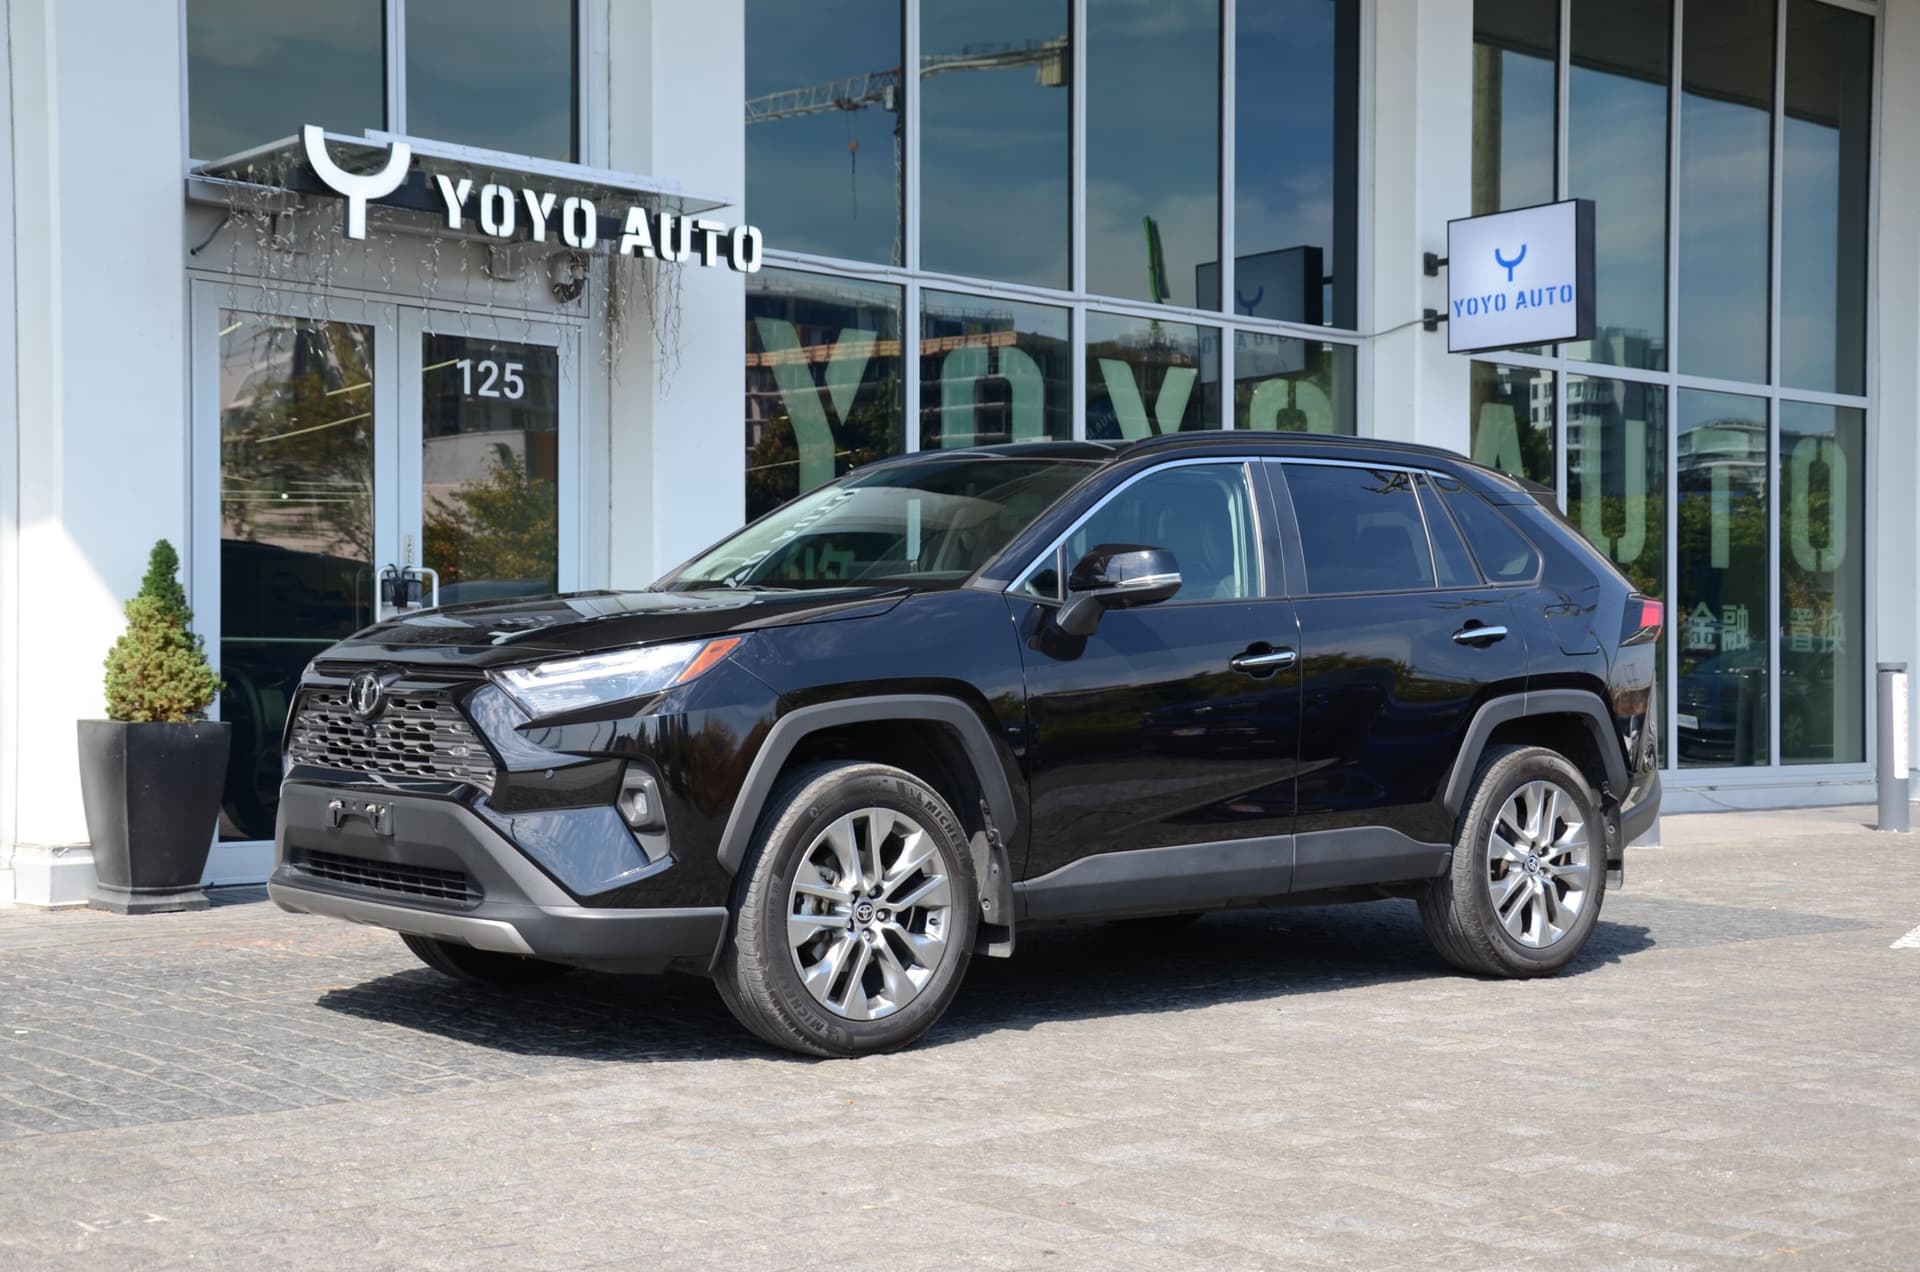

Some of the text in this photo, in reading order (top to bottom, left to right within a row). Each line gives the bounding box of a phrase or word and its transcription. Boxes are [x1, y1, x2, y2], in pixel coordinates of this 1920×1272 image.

[431, 173, 764, 274] YOYO AUTO
[1453, 284, 1573, 318] YOYO AUTO
[455, 359, 525, 400] 125
[1687, 601, 1750, 652] 金融
